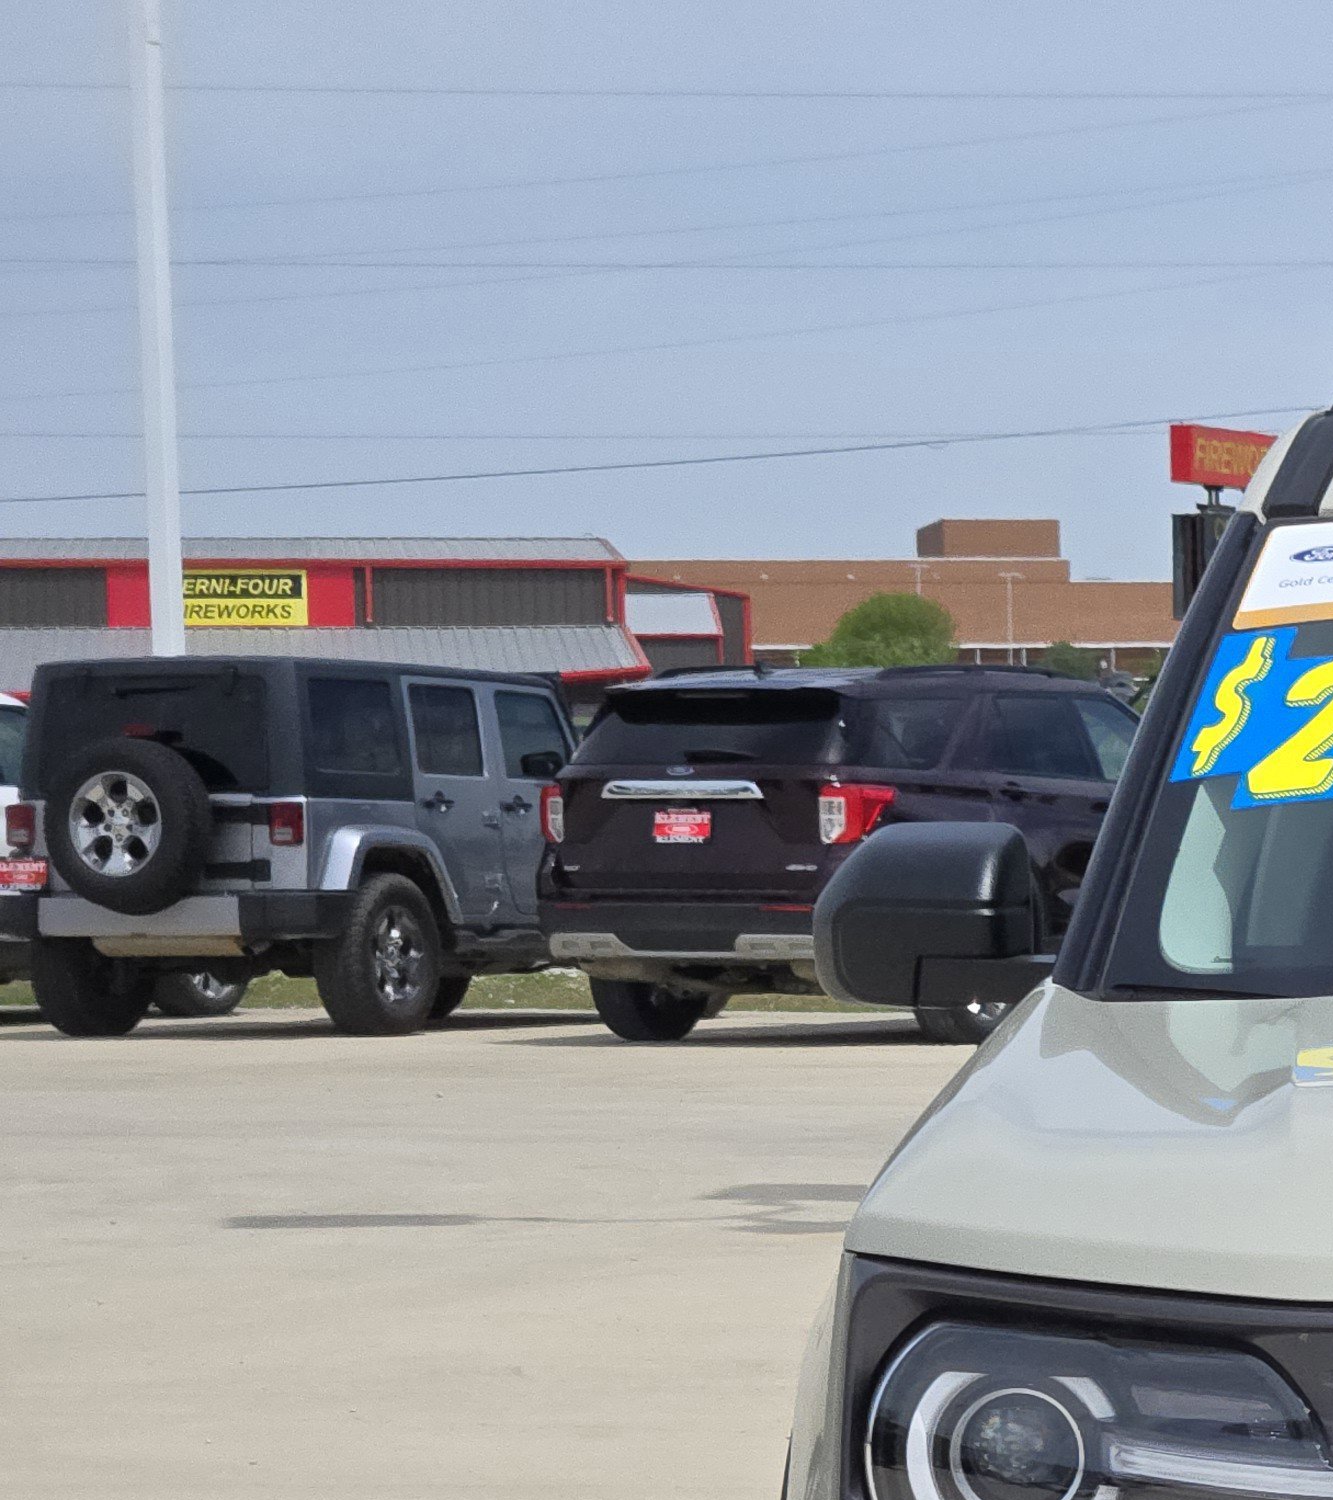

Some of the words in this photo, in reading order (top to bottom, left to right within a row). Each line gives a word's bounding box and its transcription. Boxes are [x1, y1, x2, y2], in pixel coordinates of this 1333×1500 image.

[1193, 438, 1268, 477] FIREWO
[182, 577, 293, 596] ERNI-FOUR
[1278, 576, 1314, 589] Gold
[183, 603, 292, 619] IREWORKS
